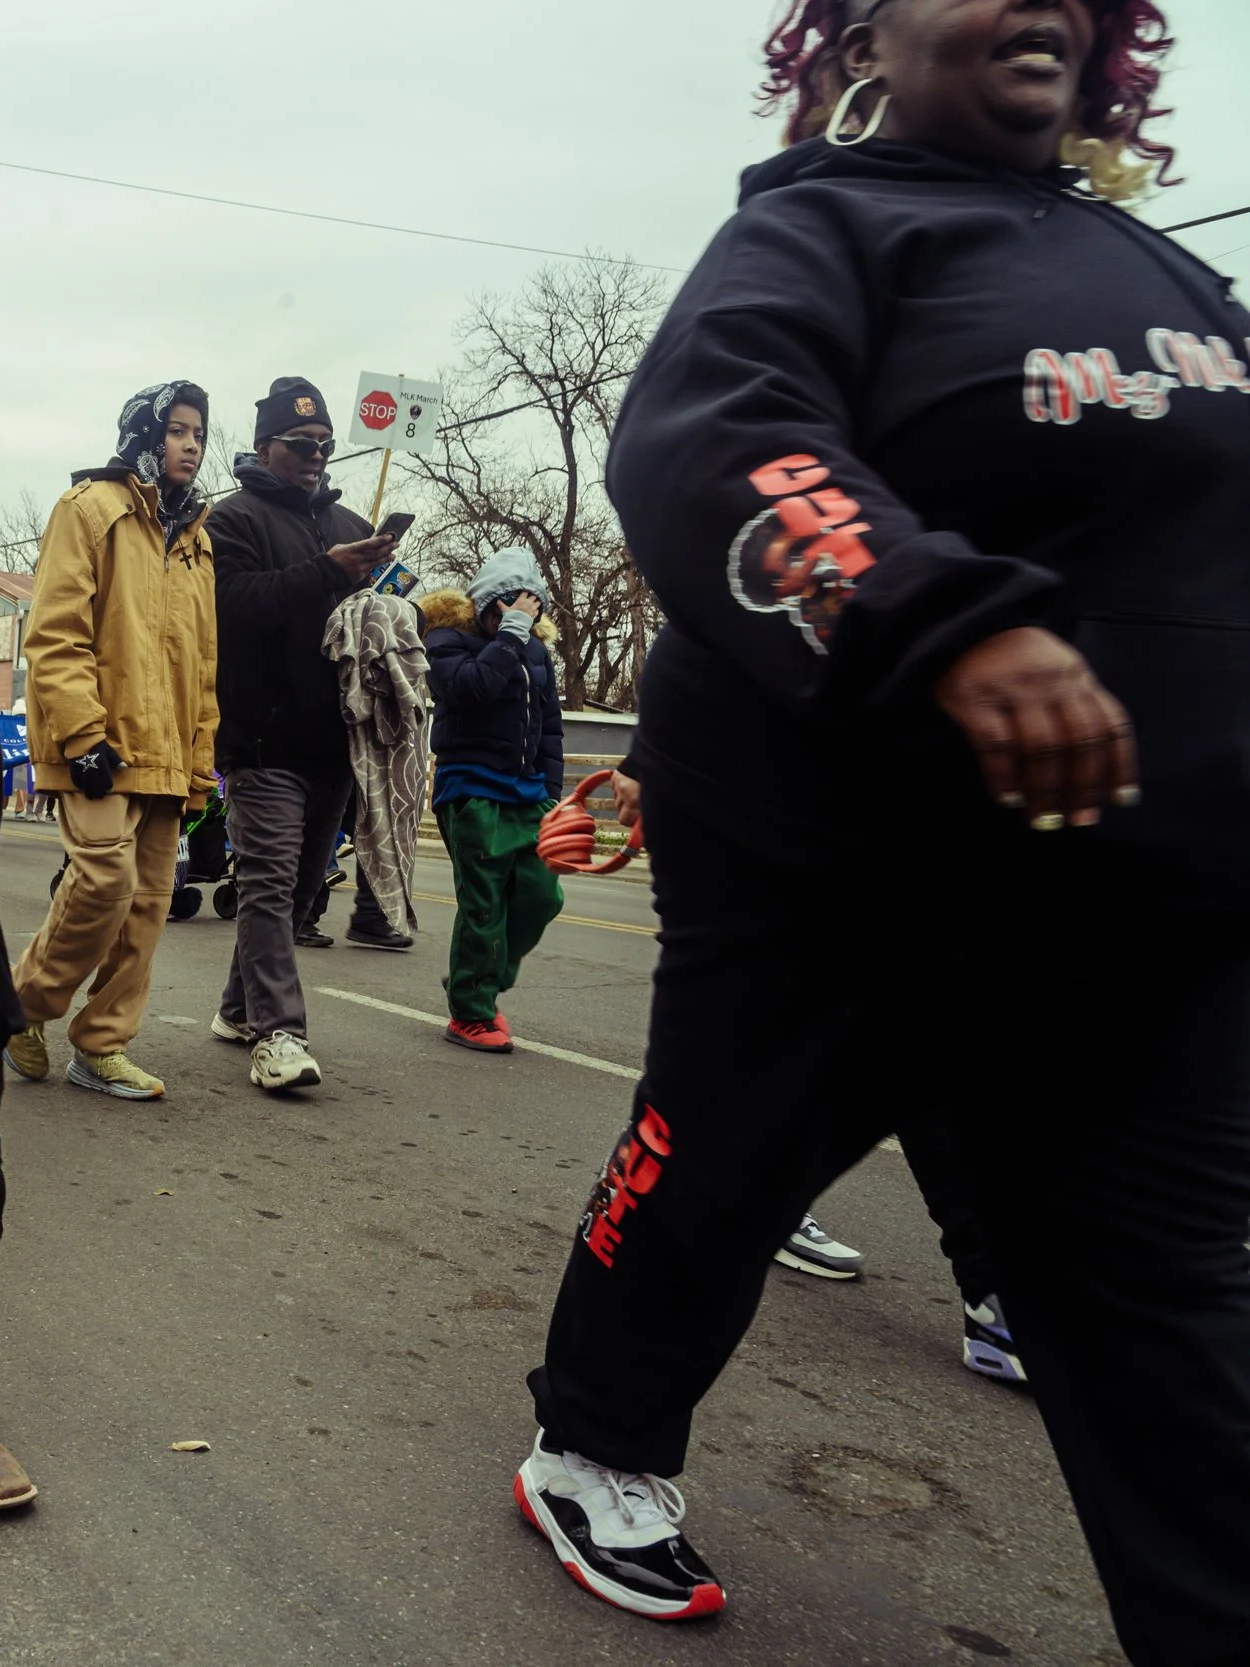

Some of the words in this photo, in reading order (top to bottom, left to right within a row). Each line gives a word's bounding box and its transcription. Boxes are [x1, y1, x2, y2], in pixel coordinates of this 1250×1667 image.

[400, 391, 415, 401] MLK
[416, 394, 438, 404] March
[359, 402, 397, 420] STOP
[405, 422, 416, 438] 8
